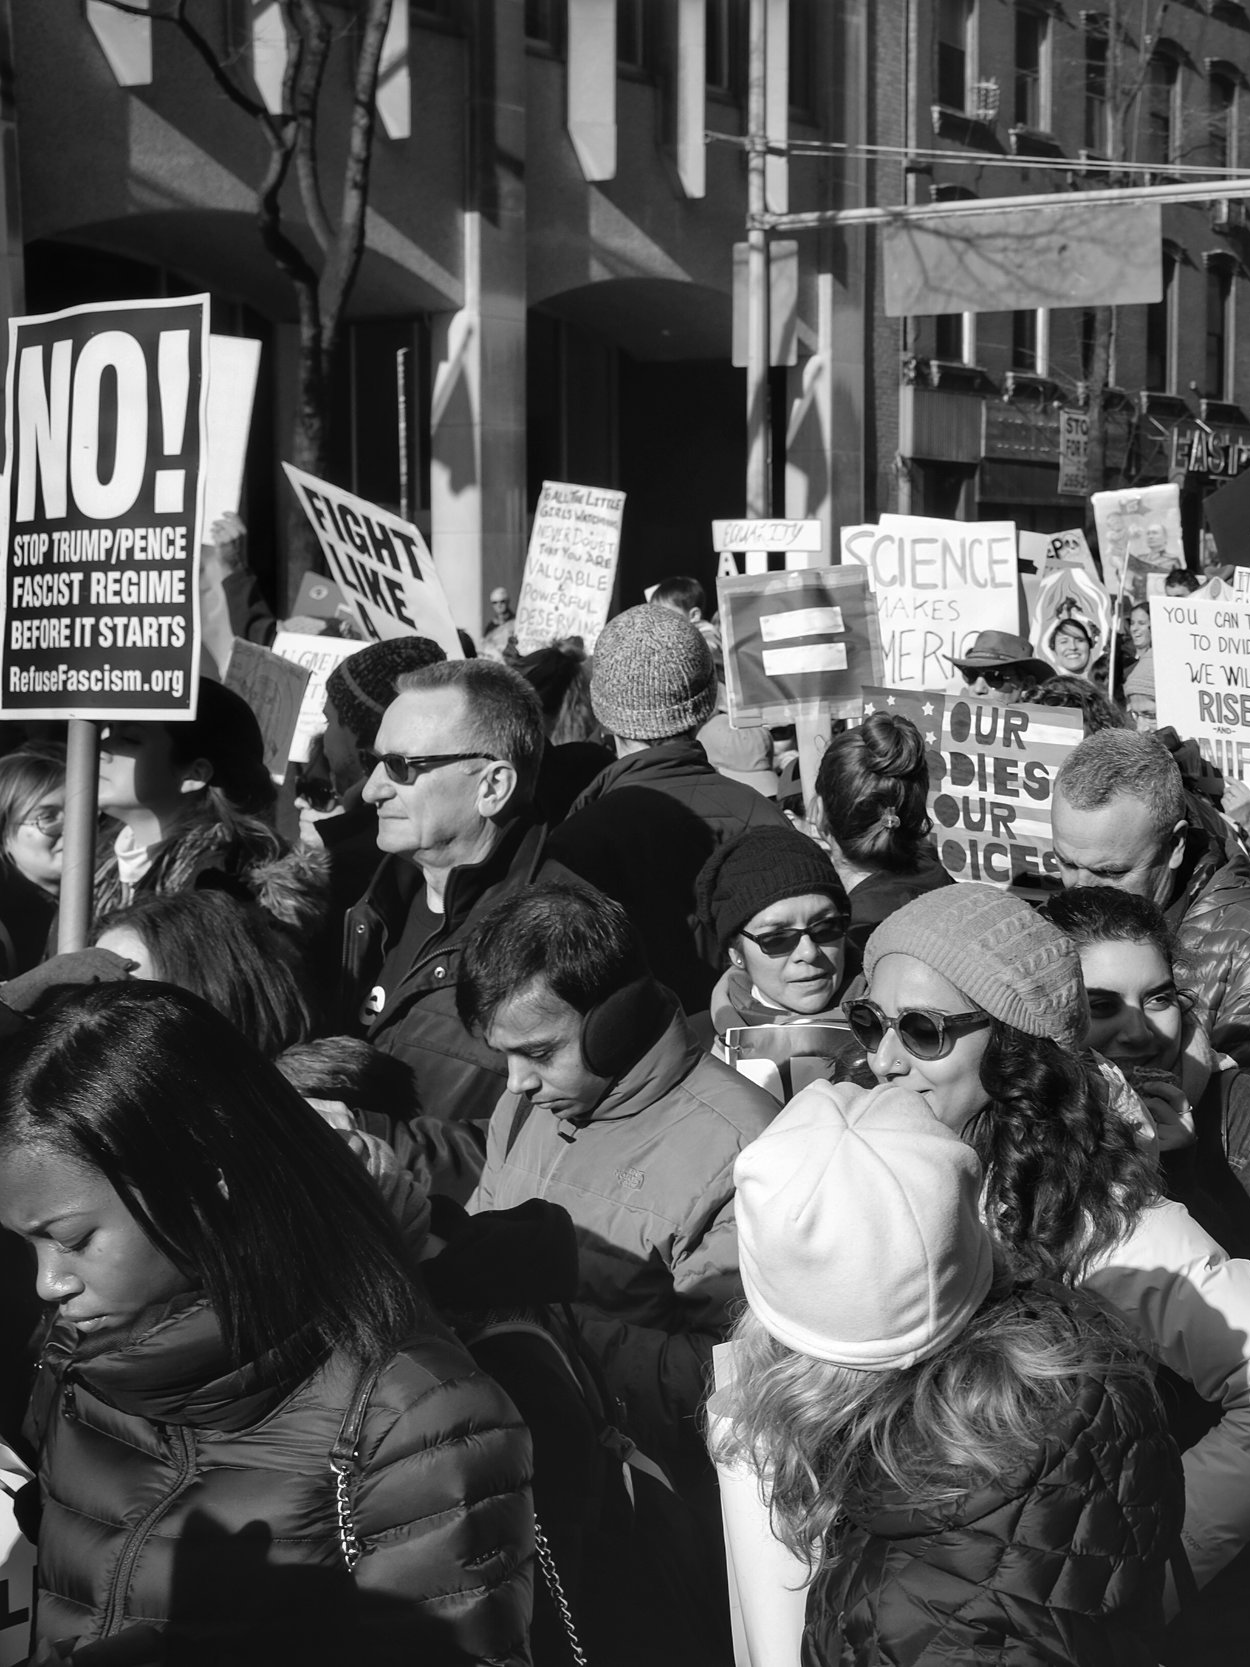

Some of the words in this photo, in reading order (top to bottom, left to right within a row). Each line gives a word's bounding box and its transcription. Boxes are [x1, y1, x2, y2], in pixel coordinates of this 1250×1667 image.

[16, 329, 190, 523] NO!
[1066, 416, 1088, 436] STO
[1172, 427, 1243, 475] EAST
[14, 533, 49, 567] STOP
[52, 526, 187, 565] TRUMP/PENCE
[300, 484, 424, 582] FIGHT
[528, 557, 608, 591] VALUABLE
[845, 530, 1013, 590] SCIENCE
[13, 572, 84, 608] FASCIST
[90, 570, 185, 604] REGIME
[327, 541, 417, 630] LIKE
[523, 582, 599, 614] POWERFUL
[11, 618, 71, 650] BEFORE
[74, 617, 95, 648] IT
[98, 616, 186, 648] STARTS
[1163, 606, 1198, 625] YOU
[1214, 611, 1239, 629] CAN
[1190, 633, 1211, 651] TO
[10, 664, 184, 697] RefuseFascism.org
[1185, 662, 1215, 685] WE
[950, 701, 1030, 751] OUR
[926, 749, 1051, 801] ODIES
[933, 793, 1018, 840] OUR
